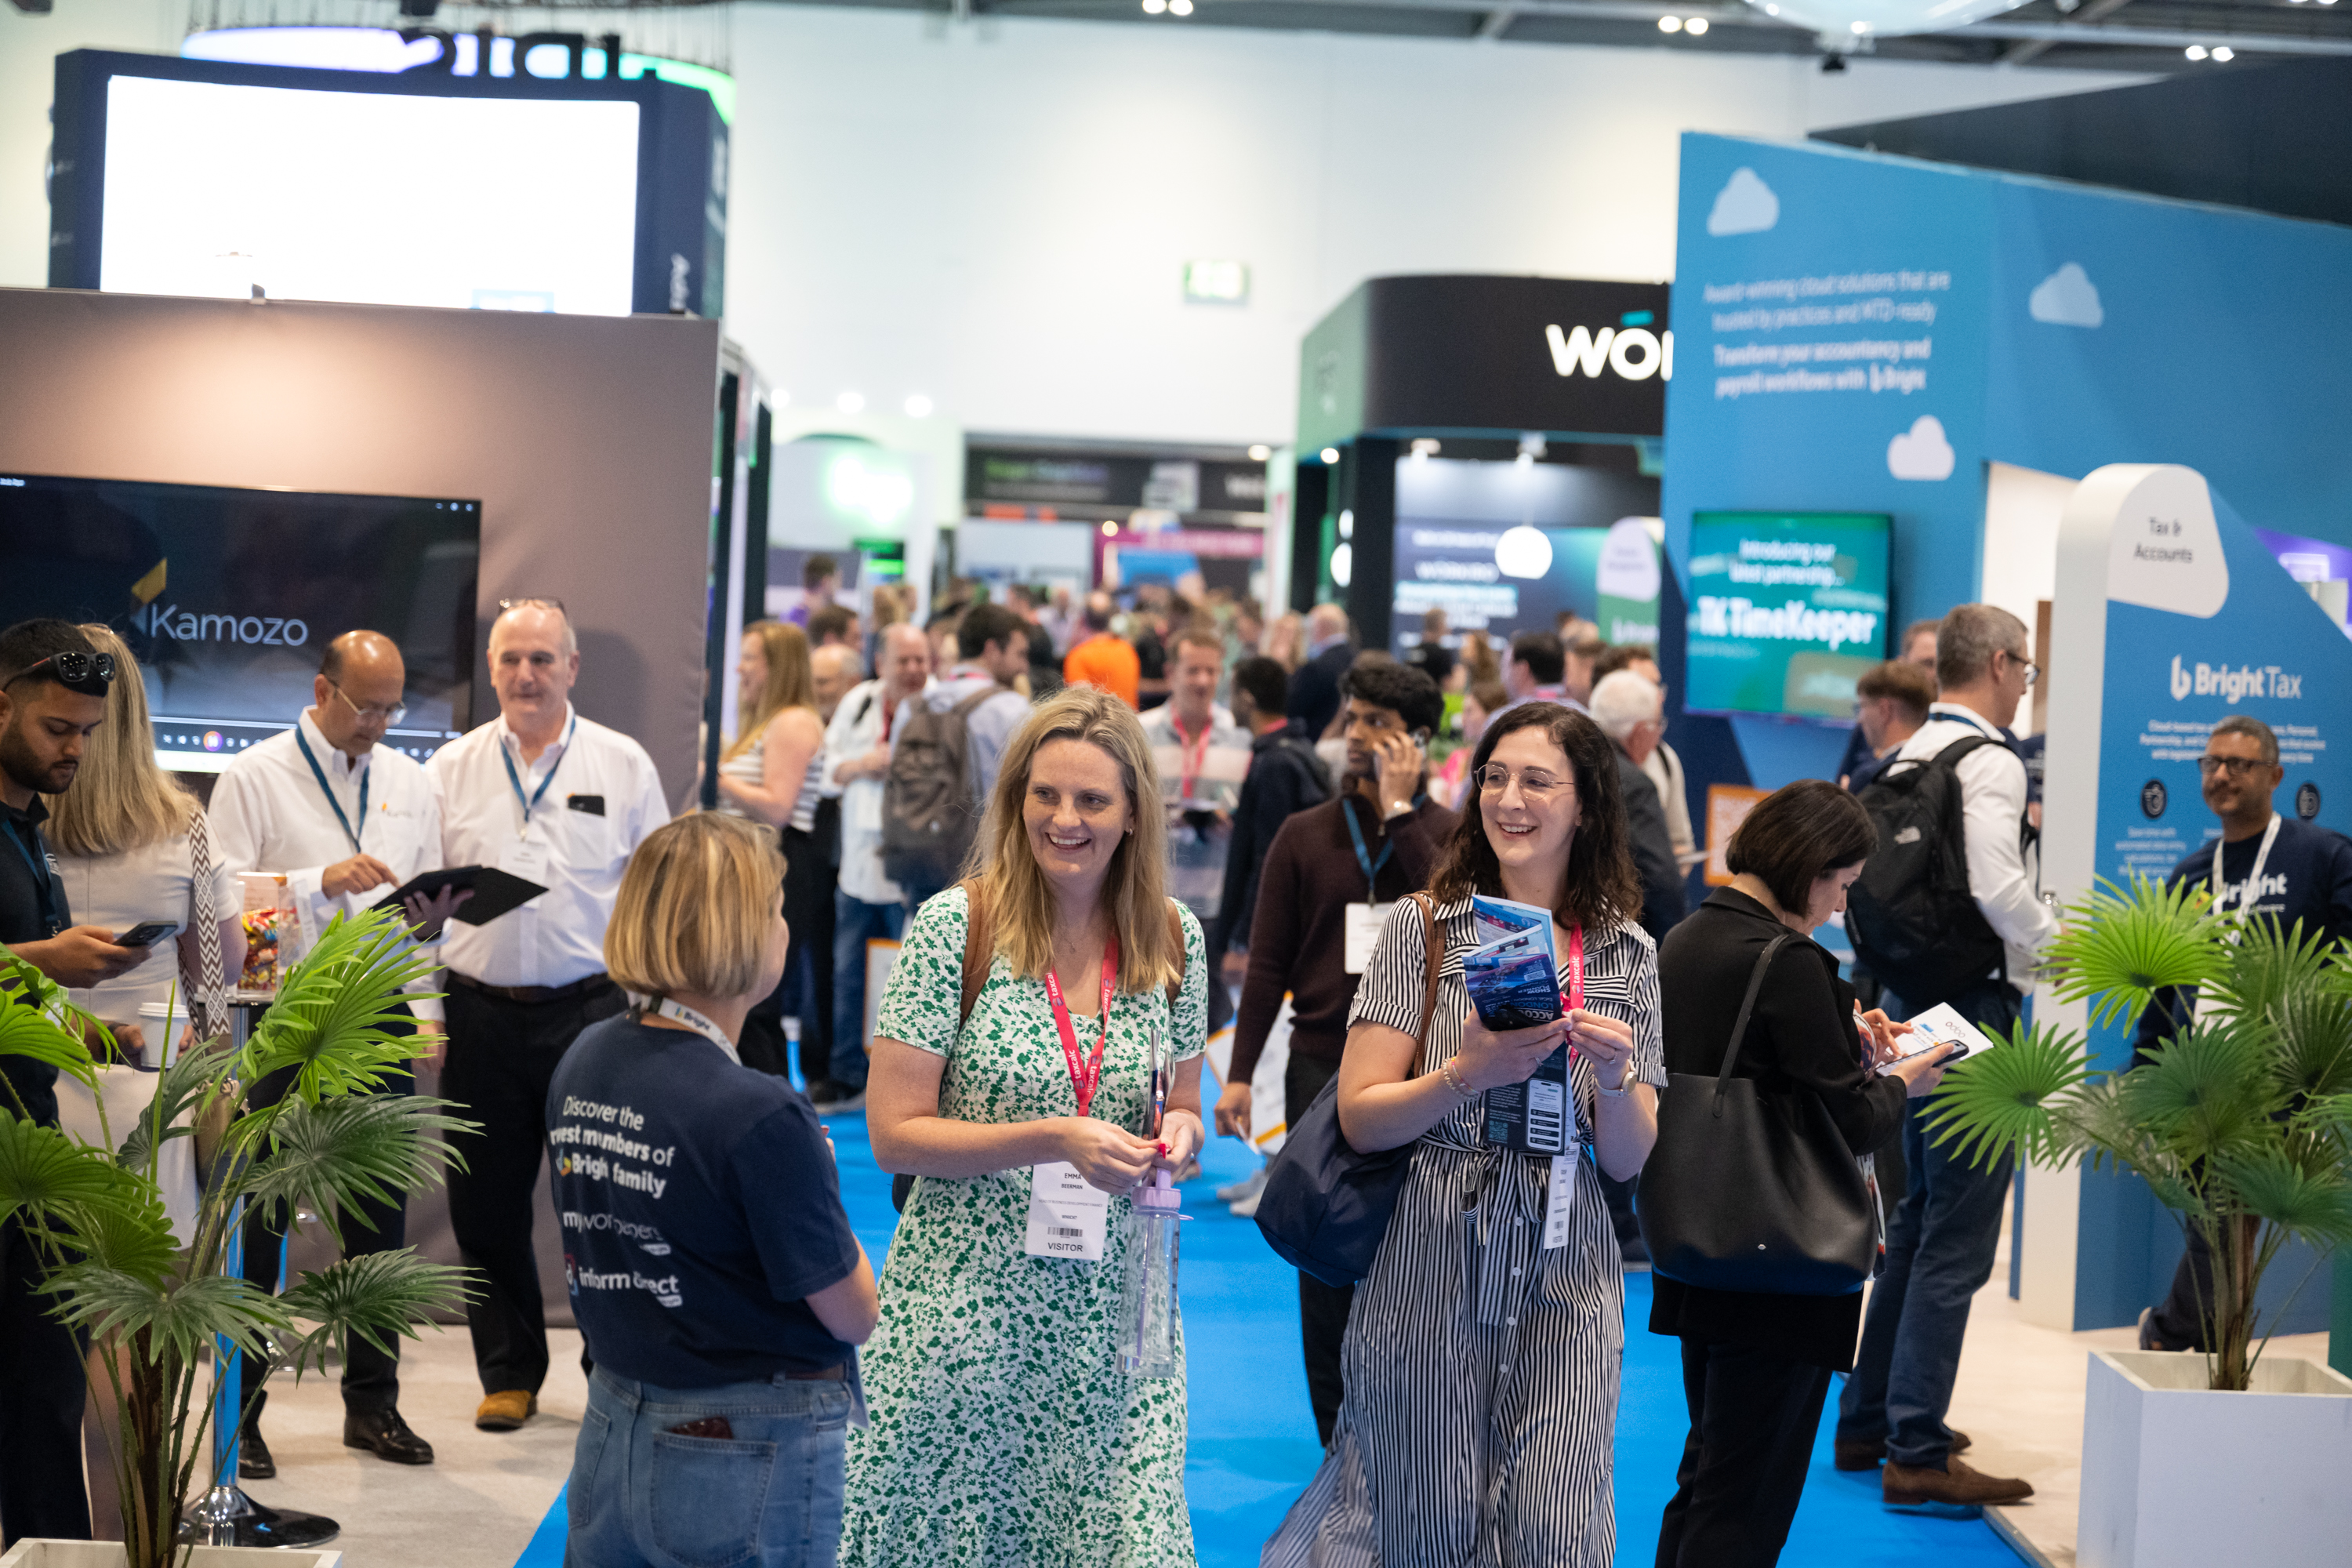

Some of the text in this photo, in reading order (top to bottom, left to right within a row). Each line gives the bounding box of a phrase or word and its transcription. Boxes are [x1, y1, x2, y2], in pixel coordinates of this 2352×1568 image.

[1798, 277, 1834, 297] cloud
[1836, 272, 1896, 295] solutions
[1899, 270, 1926, 292] that
[1928, 272, 1950, 291] are
[1712, 310, 1756, 332] trusted
[1758, 309, 1773, 332] by
[1775, 307, 1831, 330] practices
[1835, 304, 1859, 325] and
[1714, 336, 1931, 368] Transform your accountancy and
[1715, 372, 1762, 400] payroll
[1765, 368, 1832, 393] workflows
[1835, 367, 1865, 390] with
[1884, 365, 1926, 394] Bright
[2149, 517, 2169, 536] Tax
[1738, 538, 1836, 565] Introducing our
[2134, 543, 2193, 564] Accounts
[1728, 563, 1762, 583] latest
[150, 604, 308, 647] Kamozo
[1729, 597, 1877, 651] TimeKeeper
[1571, 956, 1581, 984] taxcalc
[1046, 972, 1058, 996] taxcal
[1945, 1022, 1965, 1038] odoo
[1068, 1048, 1081, 1079] taxcalc
[563, 1095, 644, 1131] Discover the
[652, 1146, 676, 1167] of
[612, 1162, 667, 1200] family
[1047, 1242, 1083, 1252] VISITOR
